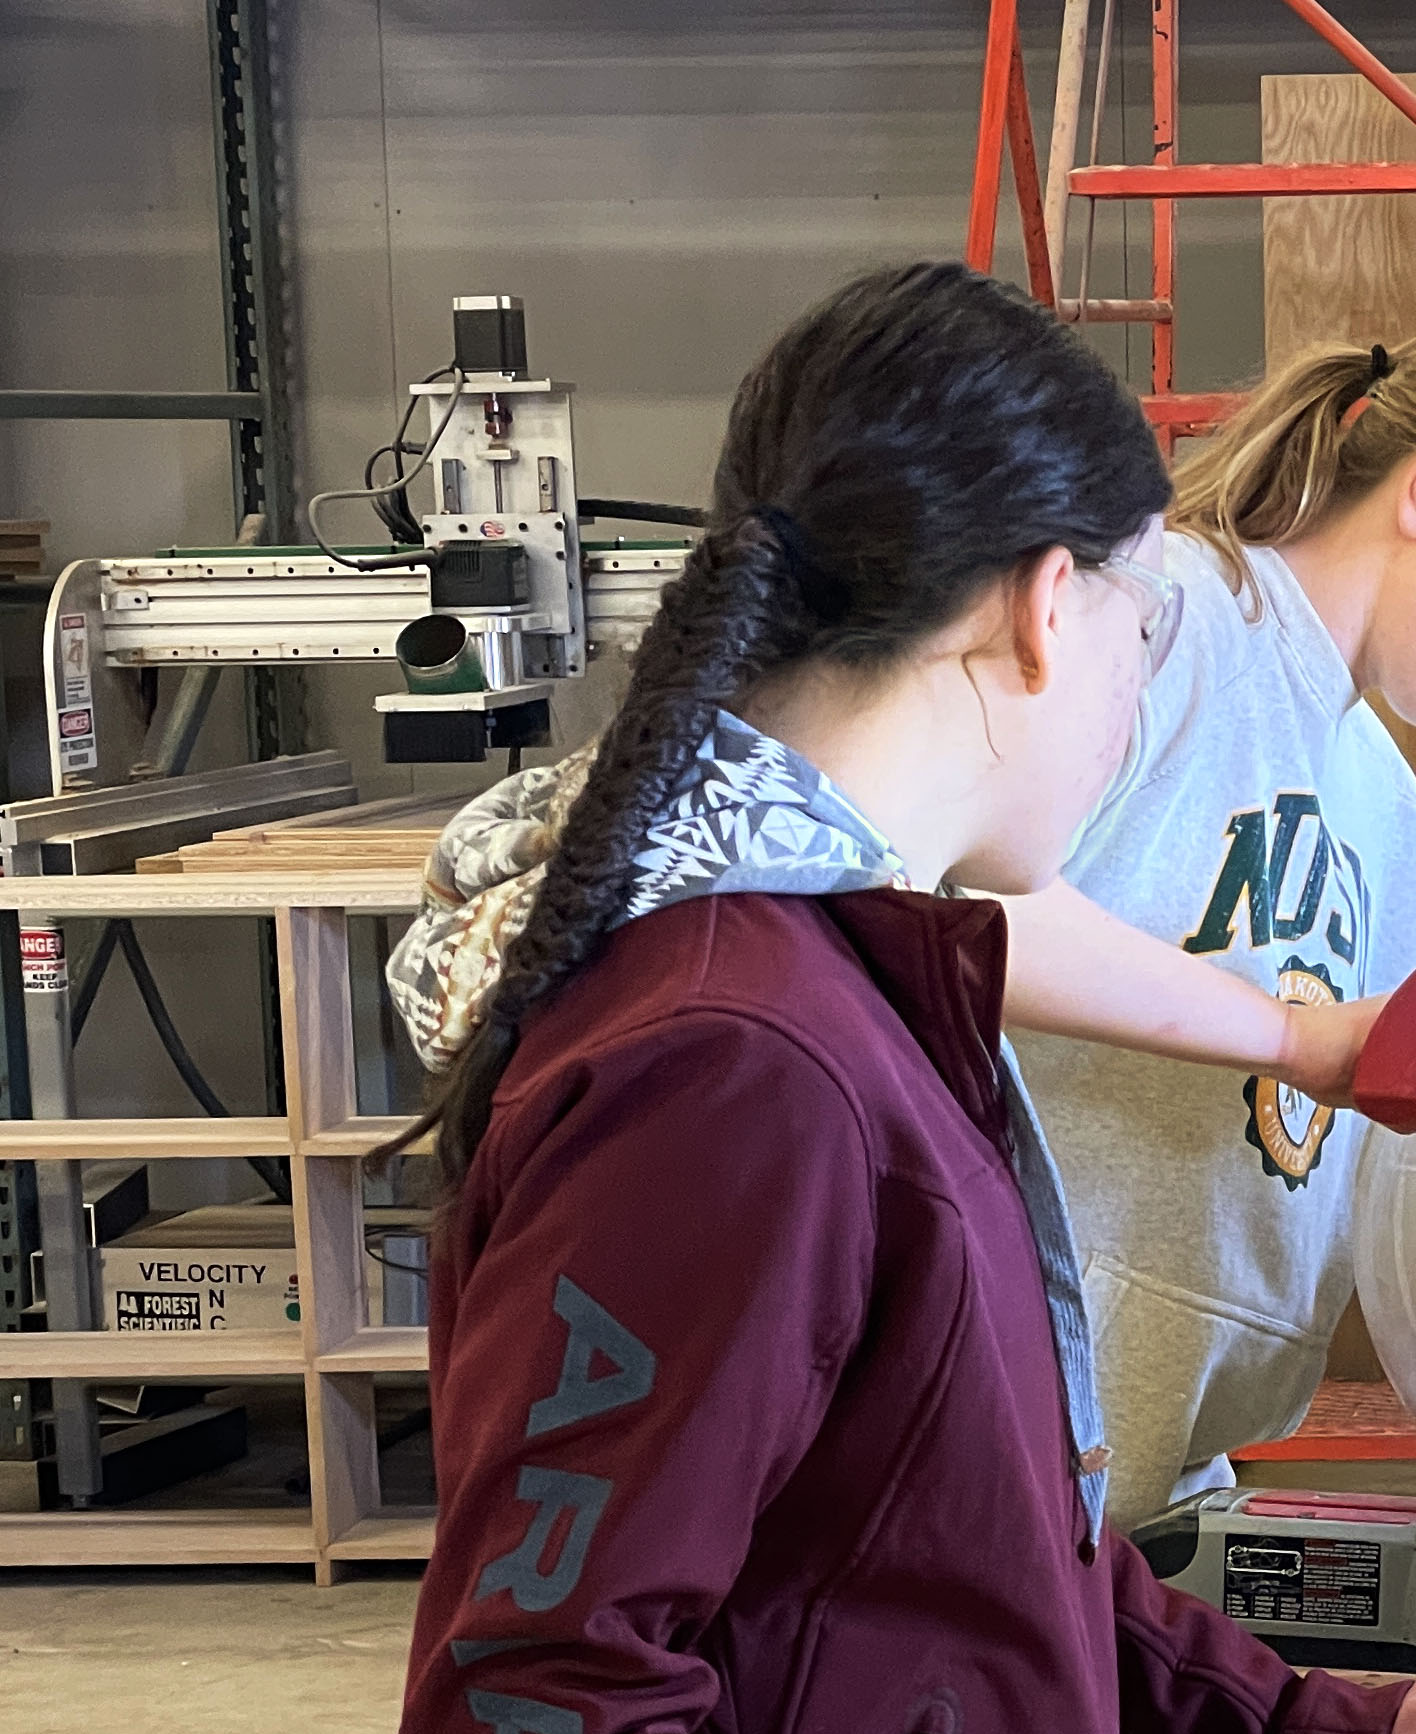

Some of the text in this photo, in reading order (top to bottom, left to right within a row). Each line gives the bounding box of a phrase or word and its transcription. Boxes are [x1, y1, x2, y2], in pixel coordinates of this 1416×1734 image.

[1181, 790, 1372, 970] NDS
[20, 937, 60, 954] ANGE
[32, 973, 57, 981] KEEP
[1279, 974, 1336, 1007] AKOT
[138, 1262, 267, 1284] VELOCITY
[143, 1295, 199, 1316] FOREST
[119, 1316, 200, 1331] SCIENTIFIC
